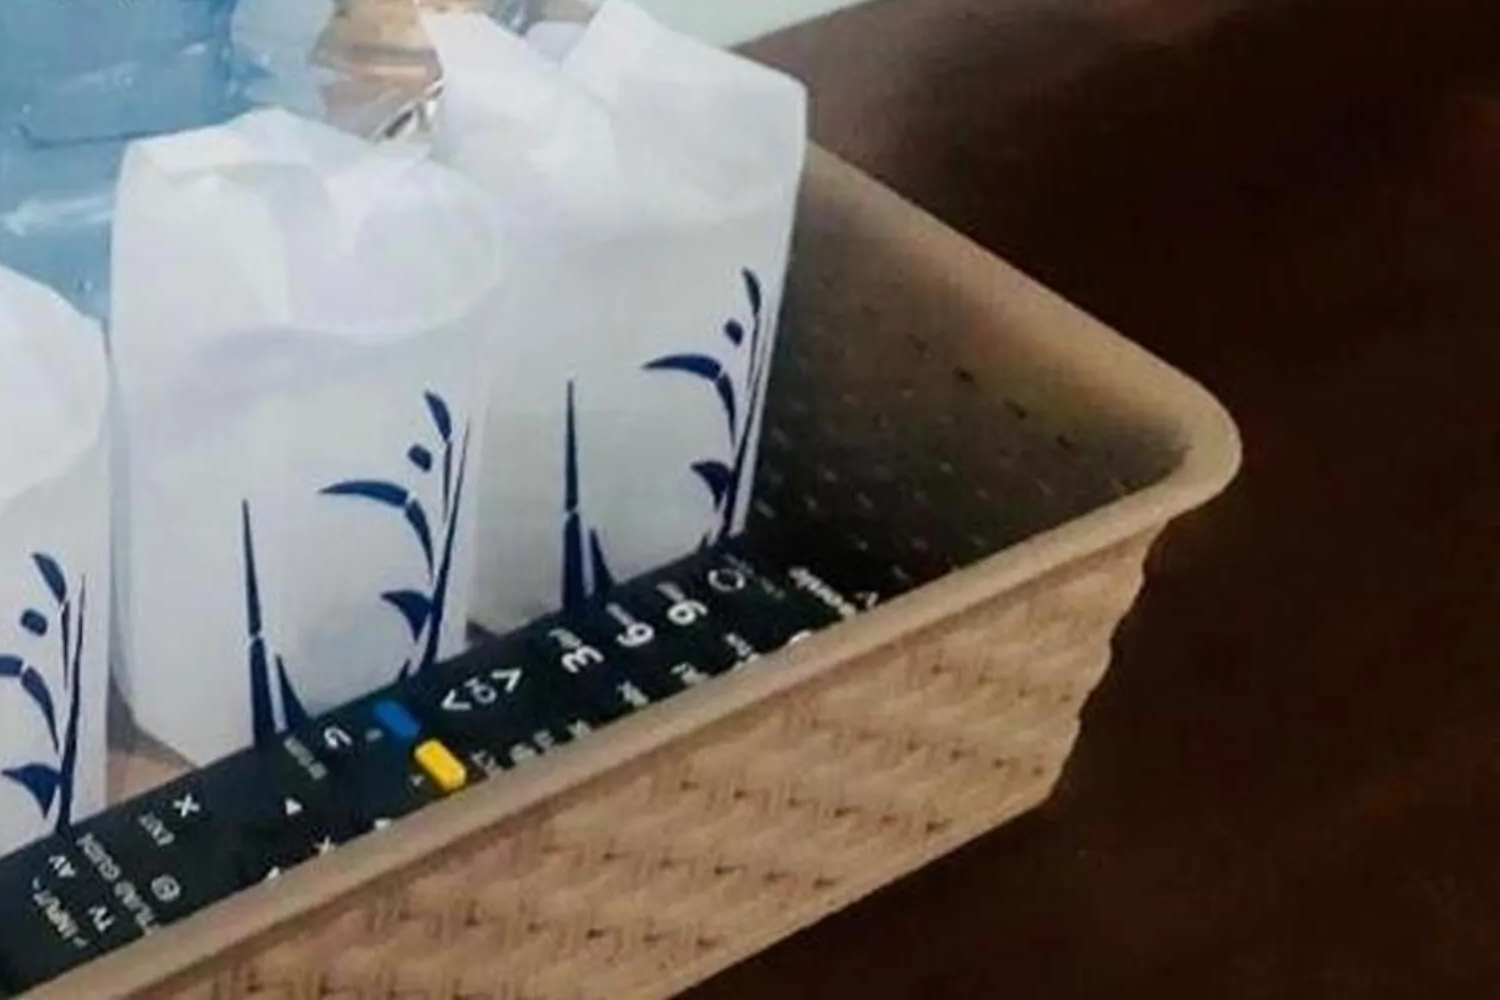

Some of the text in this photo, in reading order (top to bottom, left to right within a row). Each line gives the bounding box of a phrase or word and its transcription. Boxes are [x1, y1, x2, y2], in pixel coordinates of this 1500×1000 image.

[666, 599, 709, 626] 9
[616, 622, 656, 649] 6
[561, 644, 604, 675] 3
[48, 854, 77, 879] AV
[87, 904, 116, 933] TV
